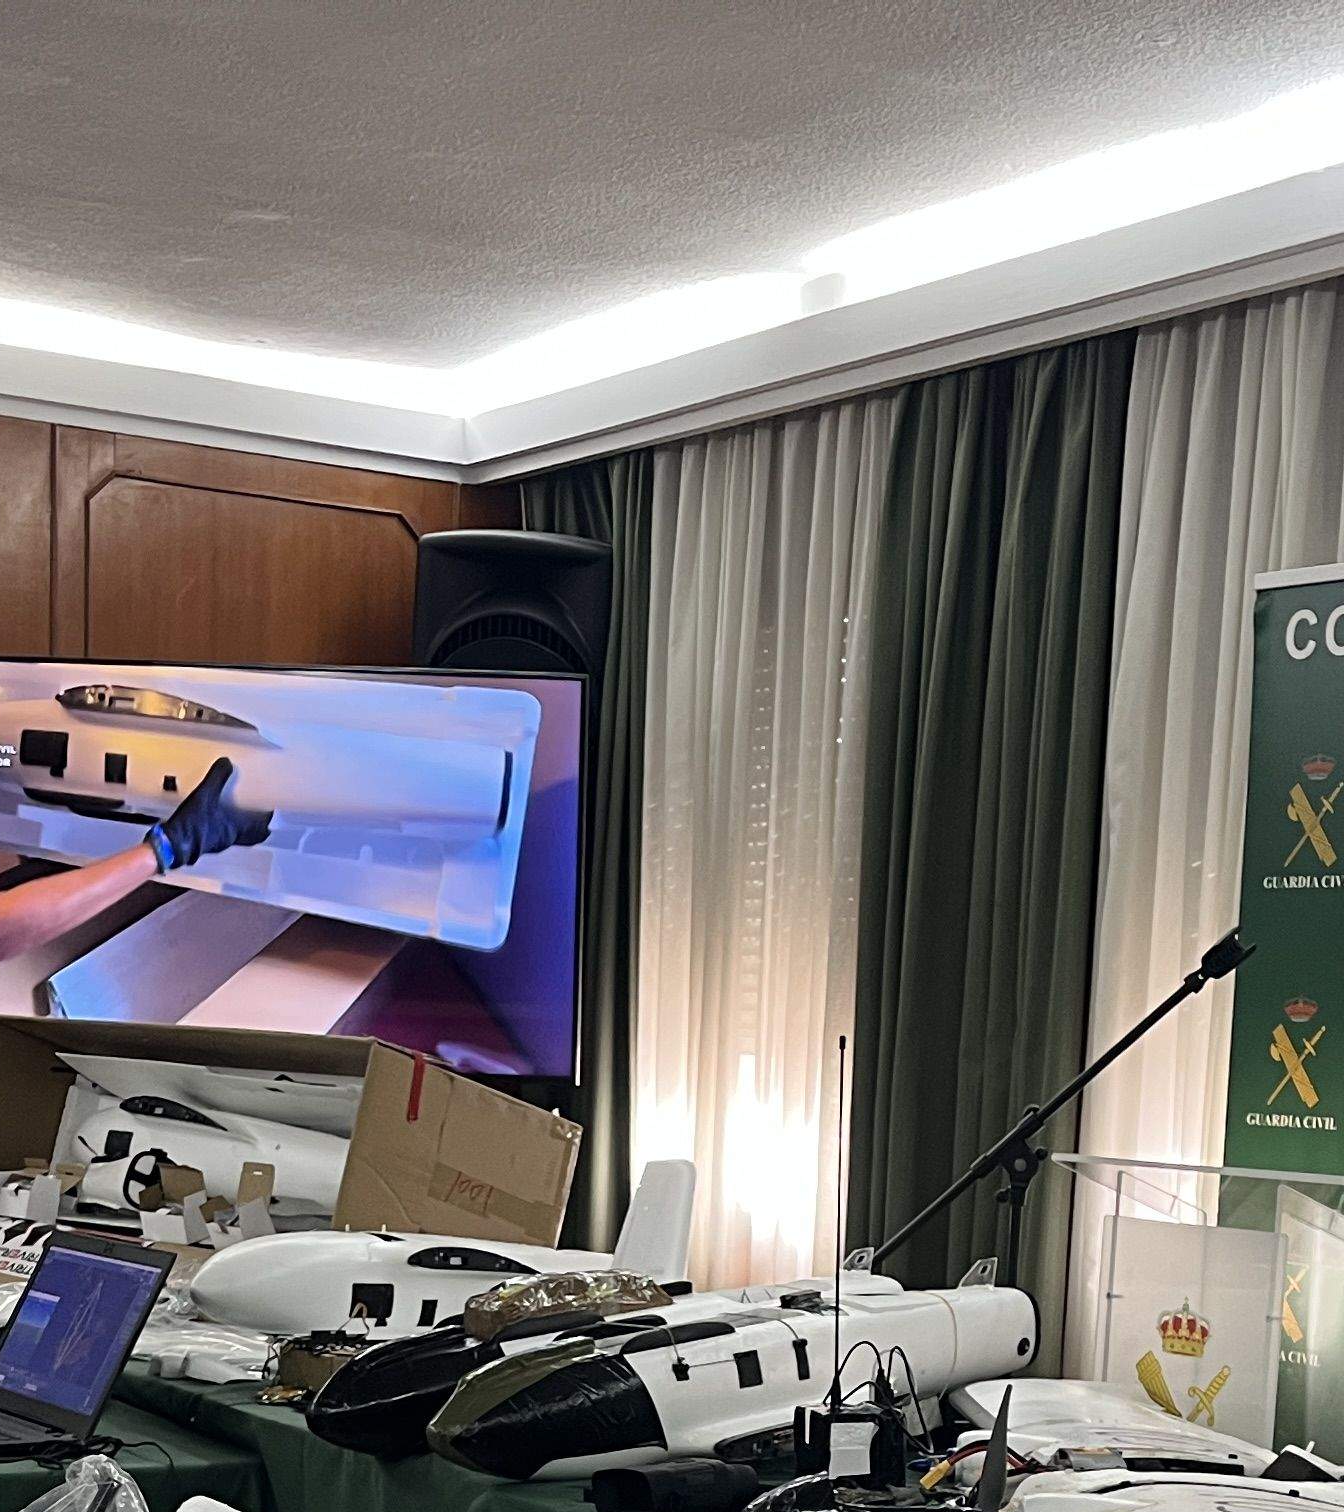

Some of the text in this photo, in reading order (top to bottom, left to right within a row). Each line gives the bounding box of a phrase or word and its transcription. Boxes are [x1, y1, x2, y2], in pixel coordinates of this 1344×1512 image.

[1262, 875, 1320, 889] GUARDIA
[1246, 1112, 1338, 1131] GUARDIA CIVIL
